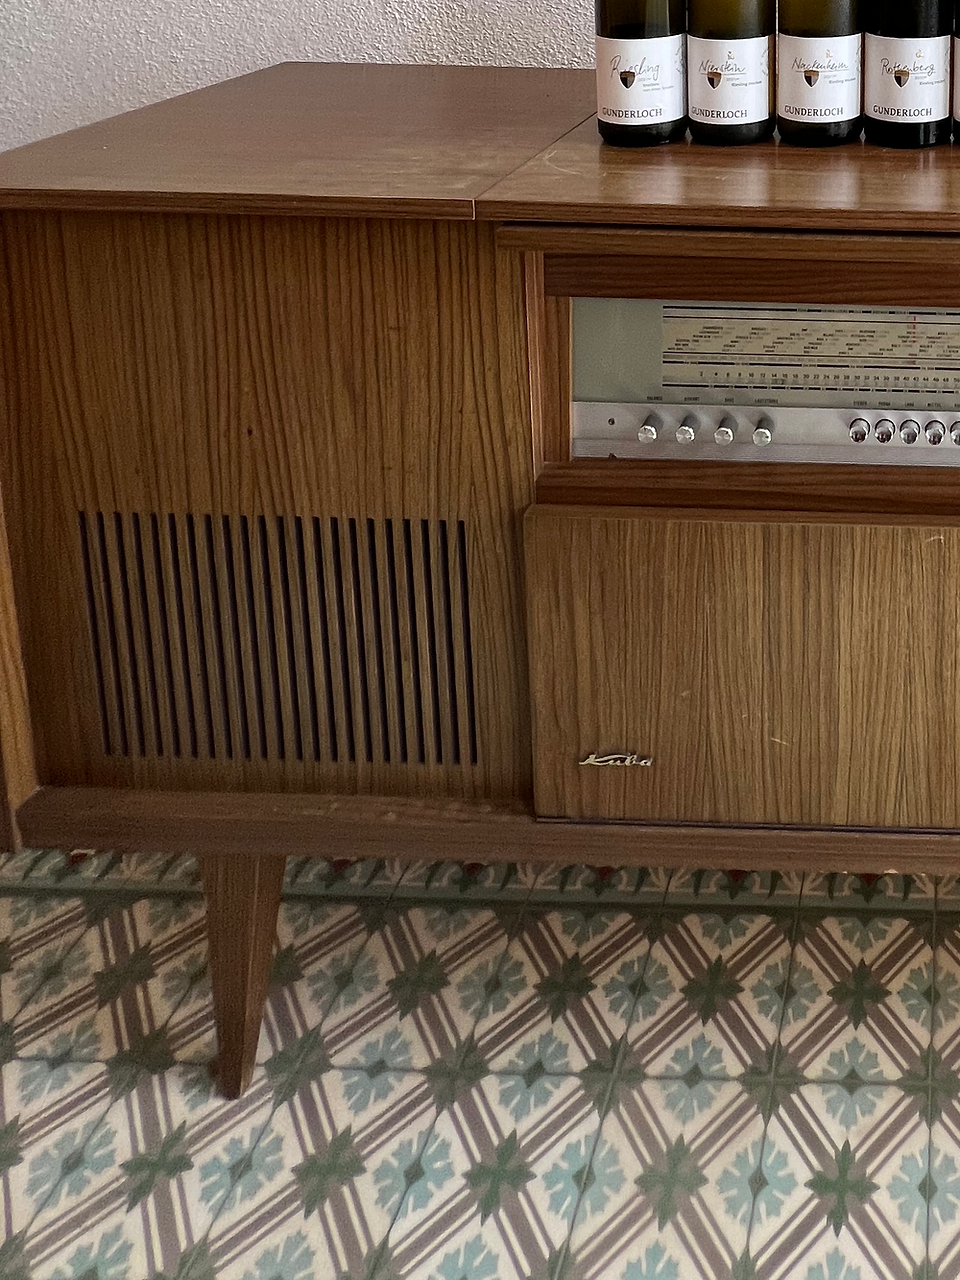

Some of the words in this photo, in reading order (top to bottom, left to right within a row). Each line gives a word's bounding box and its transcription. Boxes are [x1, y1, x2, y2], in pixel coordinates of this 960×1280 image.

[602, 107, 663, 118] GUNDERLOCH
[691, 106, 748, 118] GUNDERLOCH
[784, 105, 844, 117] GUNDERLOCH
[873, 105, 933, 117] GUNDERLOCH
